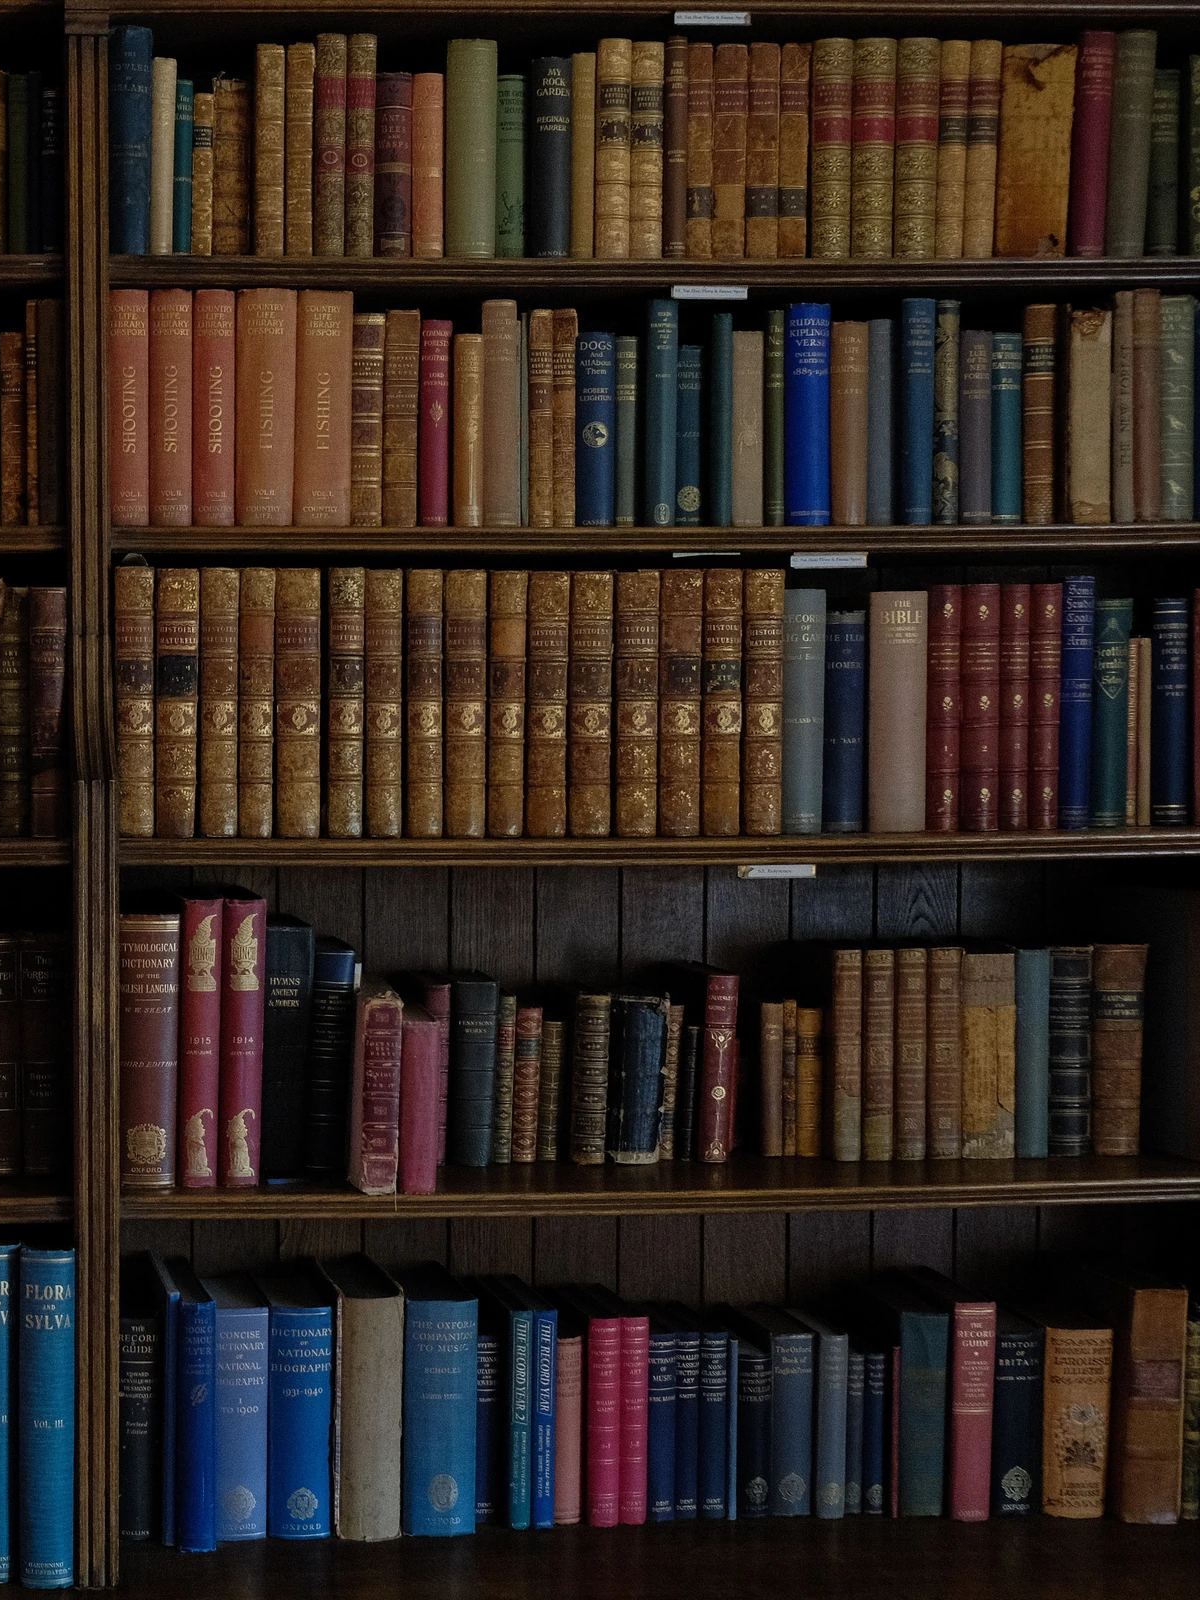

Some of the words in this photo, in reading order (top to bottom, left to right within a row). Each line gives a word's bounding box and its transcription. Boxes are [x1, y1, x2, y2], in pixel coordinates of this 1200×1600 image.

[548, 68, 561, 77] MY
[542, 77, 566, 87] ROCK
[536, 87, 570, 98] GARDEN
[536, 116, 570, 124] REGINALD
[111, 304, 146, 313] COUNTRY
[152, 304, 189, 313] COUNTRY
[248, 304, 285, 312] COUNTRY
[305, 305, 341, 313] COUNTRY
[789, 318, 830, 327] RUDYARD
[580, 341, 613, 351] DOGS
[586, 367, 606, 375] Them
[123, 365, 136, 454] SHOOTING
[163, 365, 177, 453] SHOOTING
[209, 365, 222, 454] SHOOTING
[259, 370, 274, 450] FISHING
[317, 371, 330, 450] FISHING
[880, 610, 922, 624] BIBLE
[121, 958, 175, 969] DICTIONARY
[270, 977, 300, 986] HYMNS
[189, 1037, 211, 1045] 1915
[232, 1036, 254, 1044] 1914
[25, 1284, 71, 1300] FLORA
[25, 1314, 71, 1330] SYLVA
[220, 1331, 260, 1340] CONCISE
[271, 1328, 333, 1337] DICTIONARY
[541, 1324, 551, 1343] THE
[957, 1330, 995, 1338] RECORD
[119, 1334, 159, 1342] RECORD
[962, 1339, 990, 1347] GUIDE
[122, 1345, 153, 1354] GUIDE
[278, 1348, 331, 1358] NATIONAL
[218, 1363, 260, 1371] NATIONAL
[271, 1363, 333, 1373] BIOGRAPHY
[515, 1345, 526, 1385] RECORD
[540, 1345, 551, 1386] RECORD
[282, 1387, 323, 1397] 1931-1940
[515, 1387, 526, 1411] YEAR
[540, 1388, 550, 1412] YEAR
[237, 1405, 258, 1416] 1900
